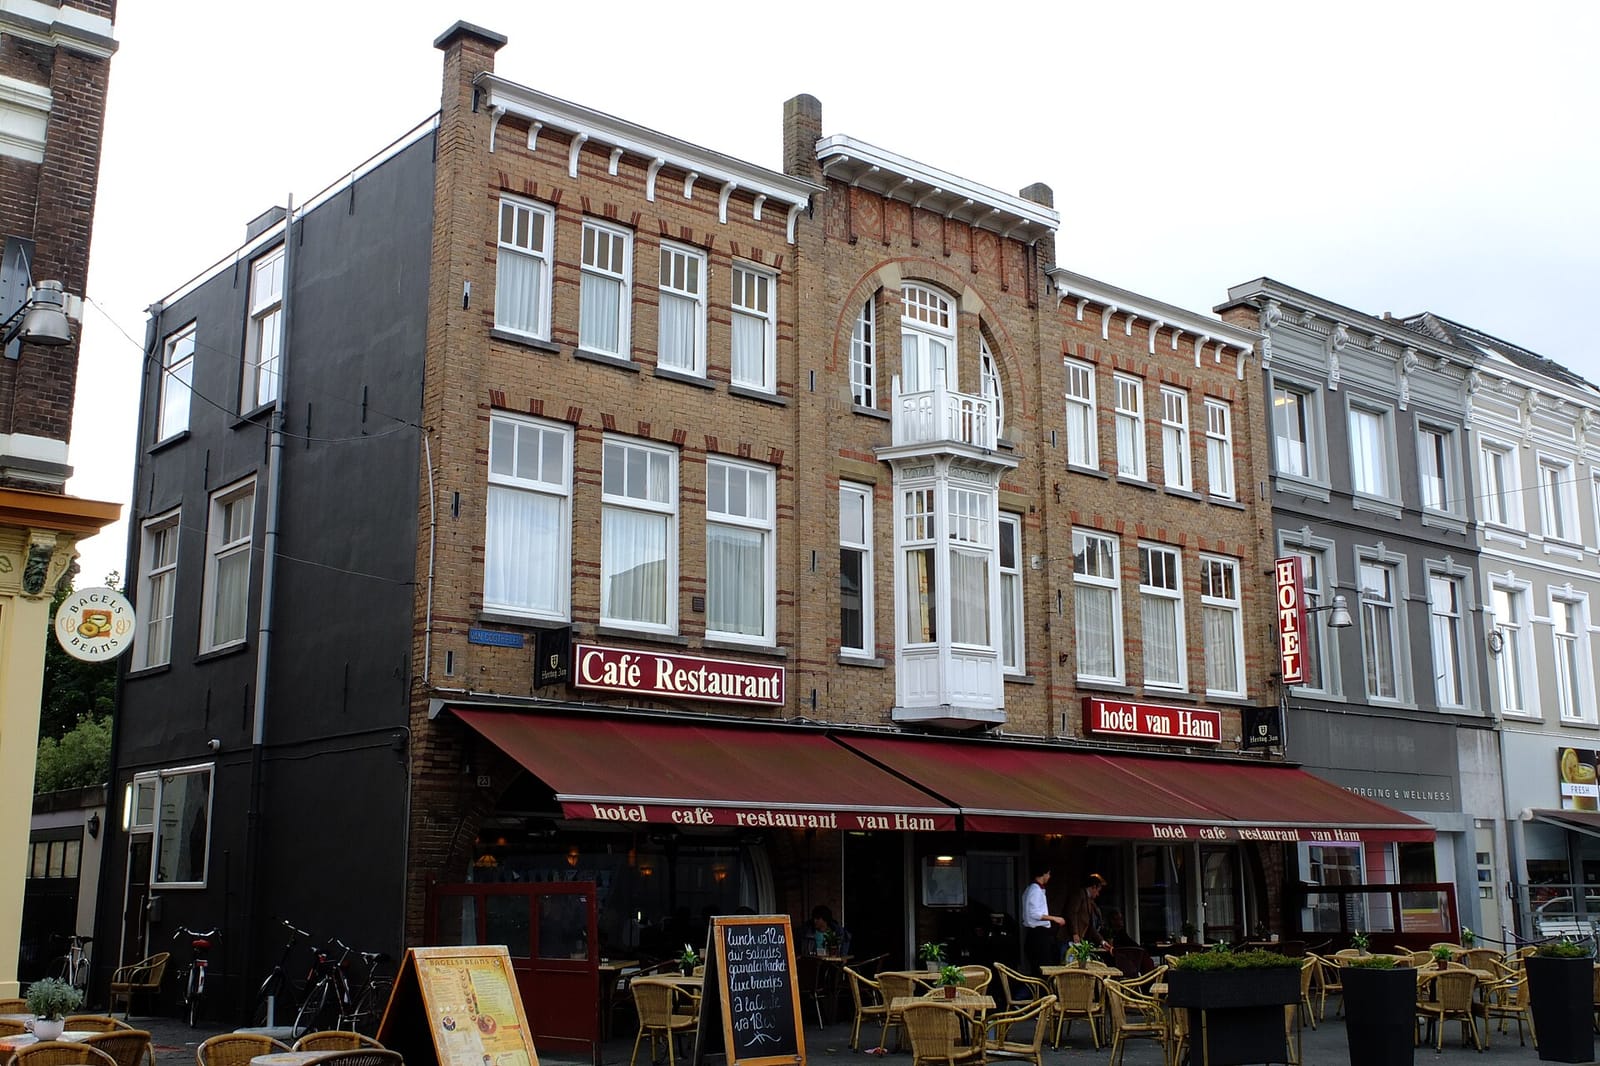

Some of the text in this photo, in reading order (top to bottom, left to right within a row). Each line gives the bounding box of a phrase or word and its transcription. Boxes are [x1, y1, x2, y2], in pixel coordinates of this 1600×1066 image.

[70, 594, 123, 613] BAGELS
[1278, 562, 1299, 679] HOTEL
[71, 637, 118, 654] BEANS
[582, 651, 780, 700] Café Restaurant
[1100, 703, 1214, 738] hotel van Ham
[1403, 790, 1451, 801] WELLNESS
[1571, 786, 1589, 794] FRESH
[591, 803, 936, 831] hotel café restaurant van Ham
[1152, 824, 1188, 839] hotel
[1238, 827, 1300, 841] restaurant
[1311, 830, 1332, 841] van
[1335, 828, 1361, 842] Ham
[728, 928, 755, 945] lunch
[745, 946, 782, 960] salades
